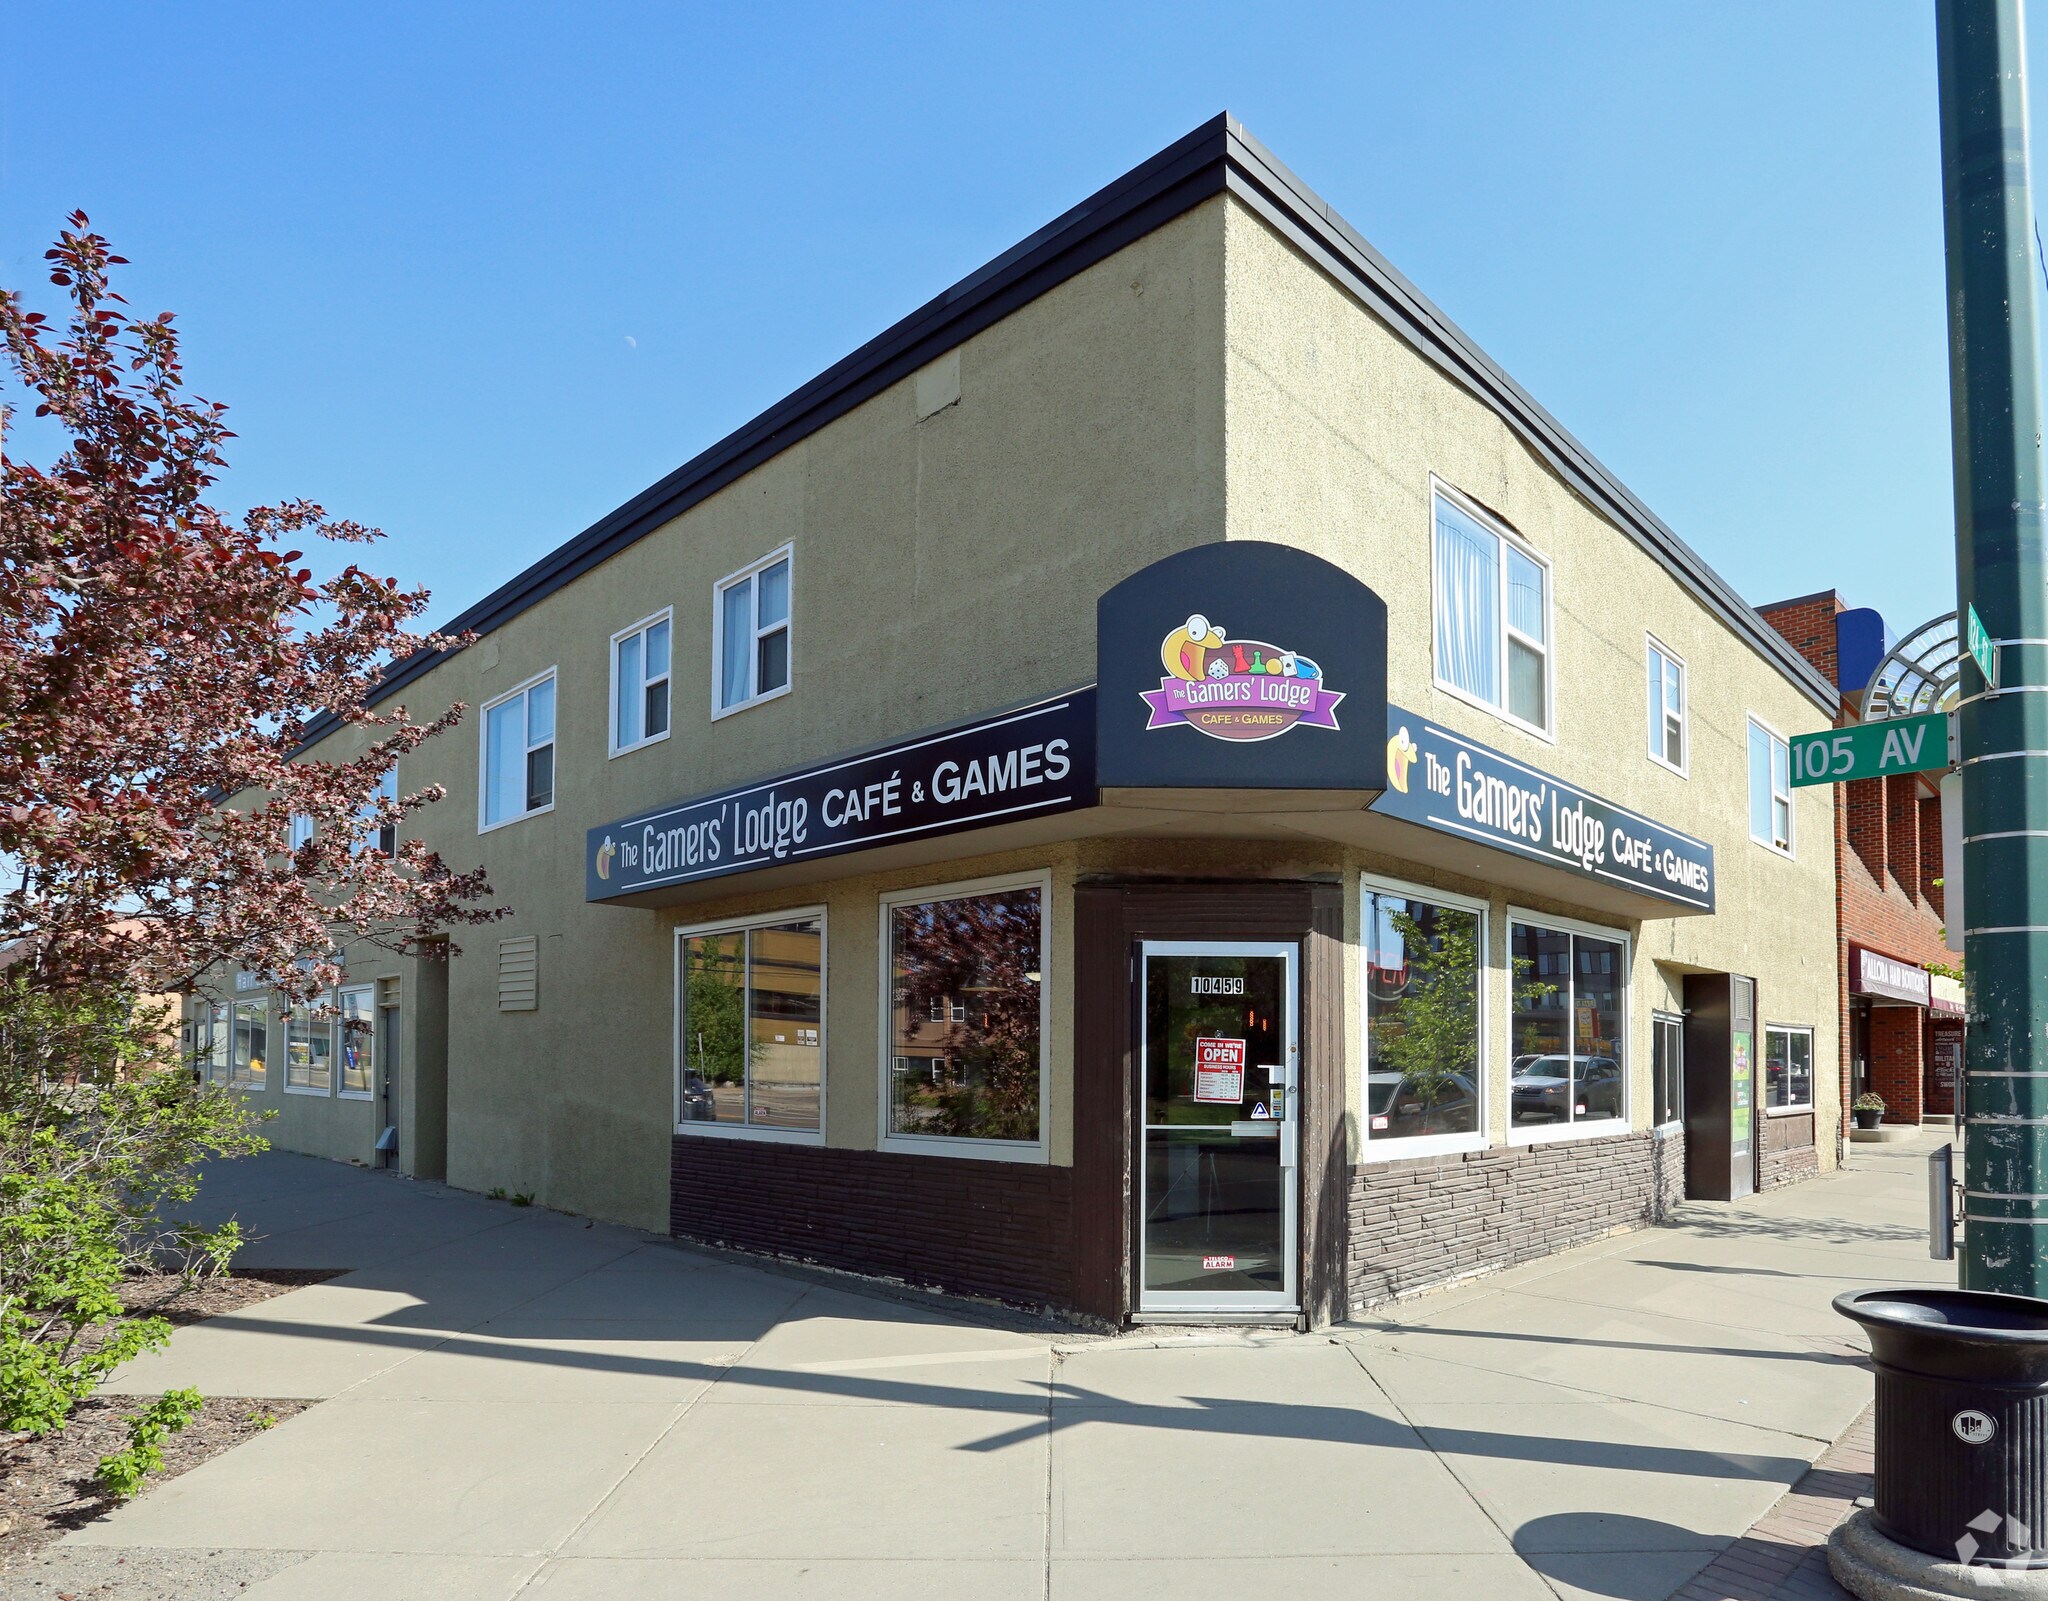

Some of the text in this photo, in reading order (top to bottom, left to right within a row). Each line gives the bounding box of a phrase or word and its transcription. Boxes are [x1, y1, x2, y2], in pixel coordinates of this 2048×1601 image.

[1173, 677, 1311, 708] The Gamers' Lodge
[1201, 713, 1232, 725] CAFE
[1241, 713, 1284, 725] GAMES
[1792, 724, 1927, 780] 105 AV
[620, 738, 1071, 875] The Gamers' Lodge CAFÉ & GAMES
[1424, 751, 1709, 893] The Gamers' Lodge CAFÉ & GAMES
[1193, 978, 1243, 993] 10459
[1203, 1048, 1238, 1062] OPEN
